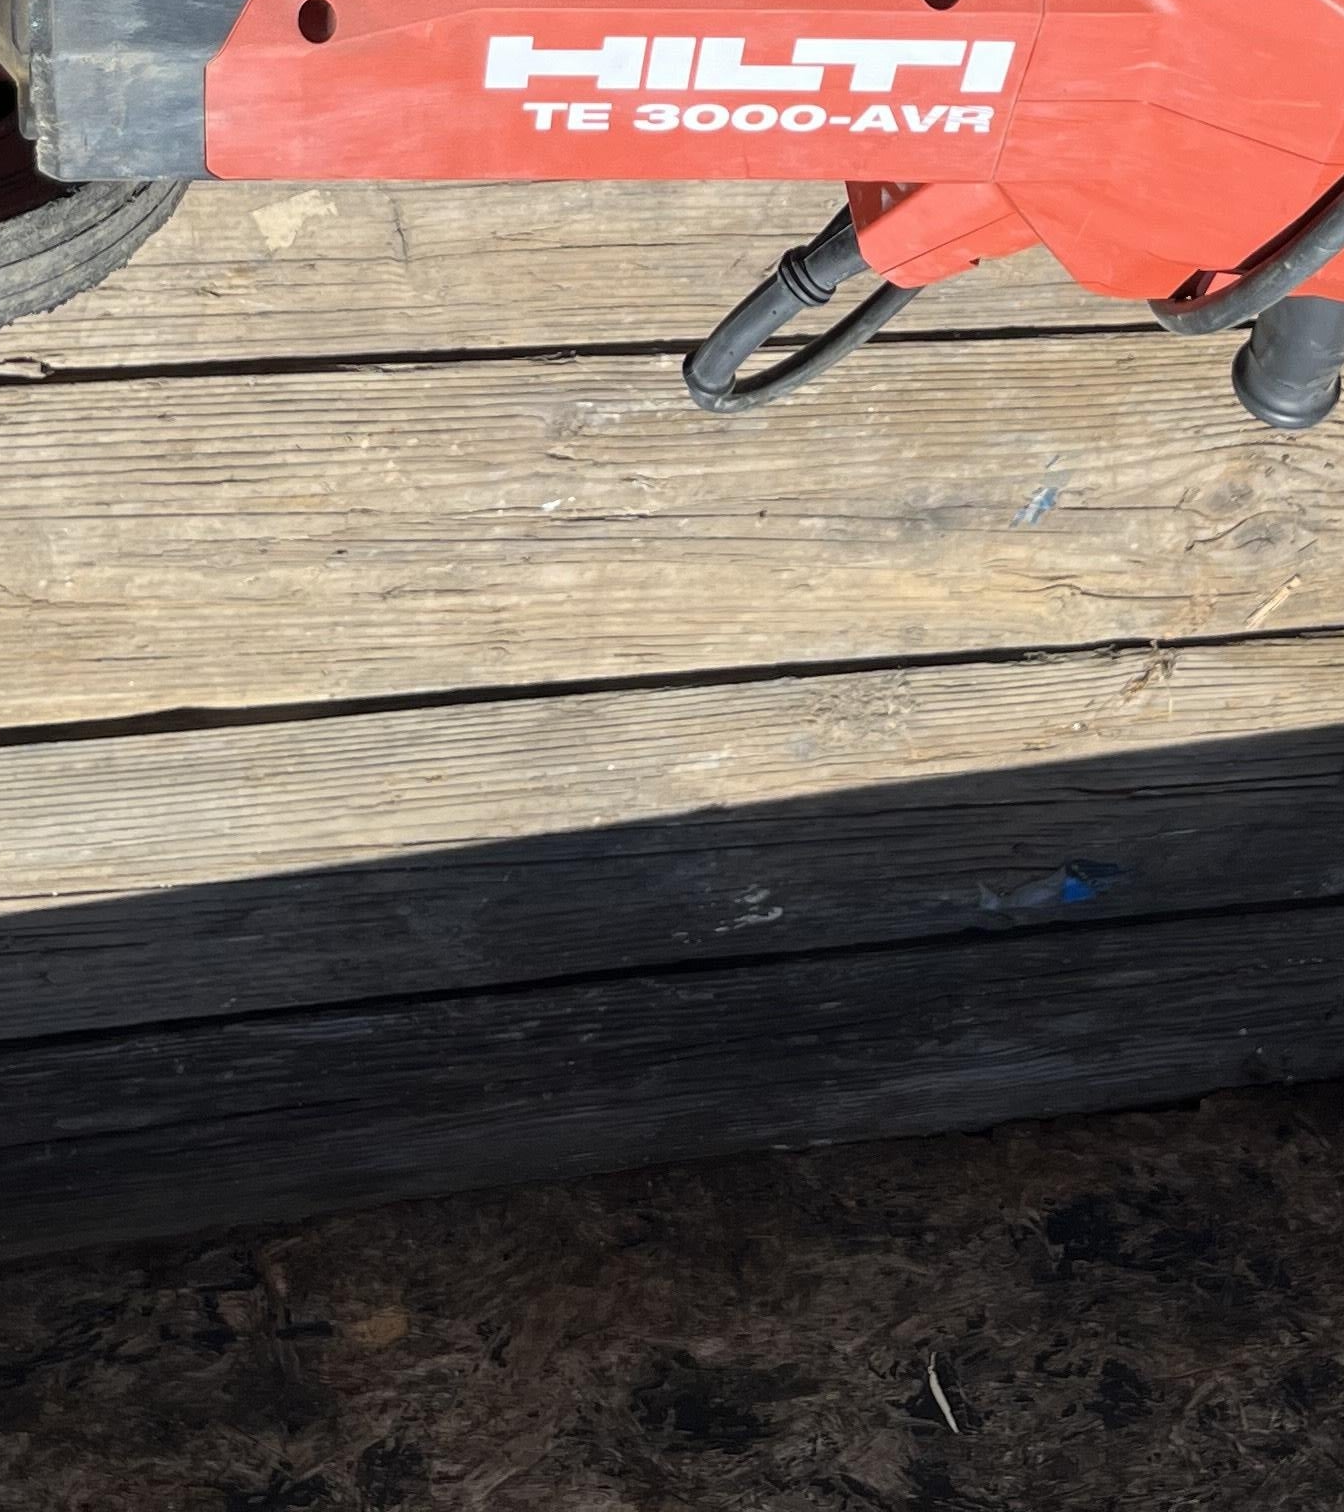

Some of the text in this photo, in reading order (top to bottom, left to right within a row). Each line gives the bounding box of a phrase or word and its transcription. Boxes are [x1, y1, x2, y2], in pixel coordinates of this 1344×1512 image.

[482, 35, 1016, 94] HILTI
[522, 102, 995, 135] TE 3000-AVR
